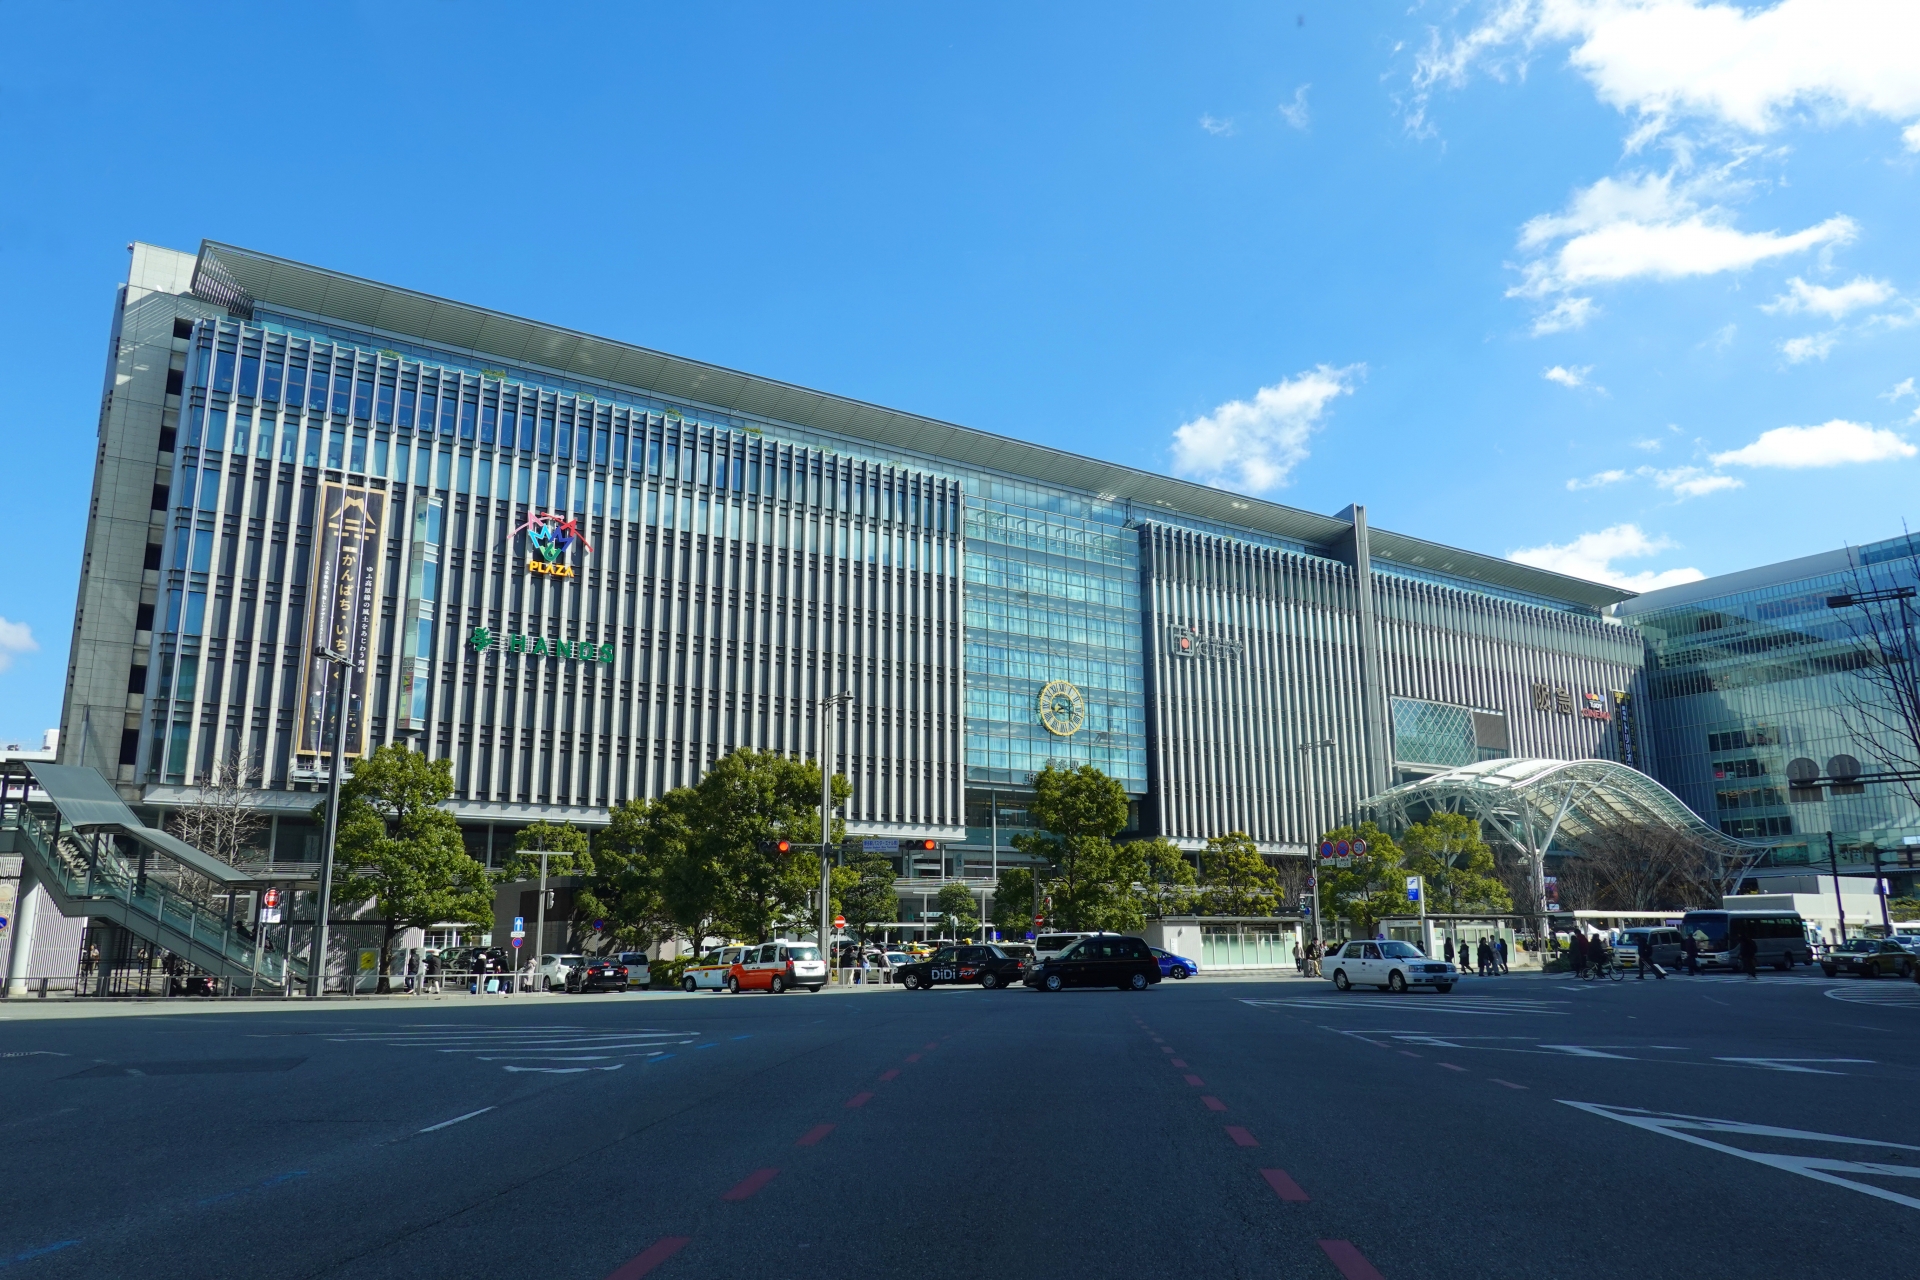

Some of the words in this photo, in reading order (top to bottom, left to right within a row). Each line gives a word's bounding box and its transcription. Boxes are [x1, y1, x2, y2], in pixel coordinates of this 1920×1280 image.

[529, 560, 575, 578] PLAZA
[334, 554, 357, 681] かんぱち・いちく
[510, 633, 614, 663] HANDS
[1198, 641, 1244, 661] CITY
[1534, 683, 1574, 715] 阪急
[1582, 708, 1612, 720] CINEMA
[1354, 843, 1363, 852] 50
[931, 968, 956, 980] DiDi
